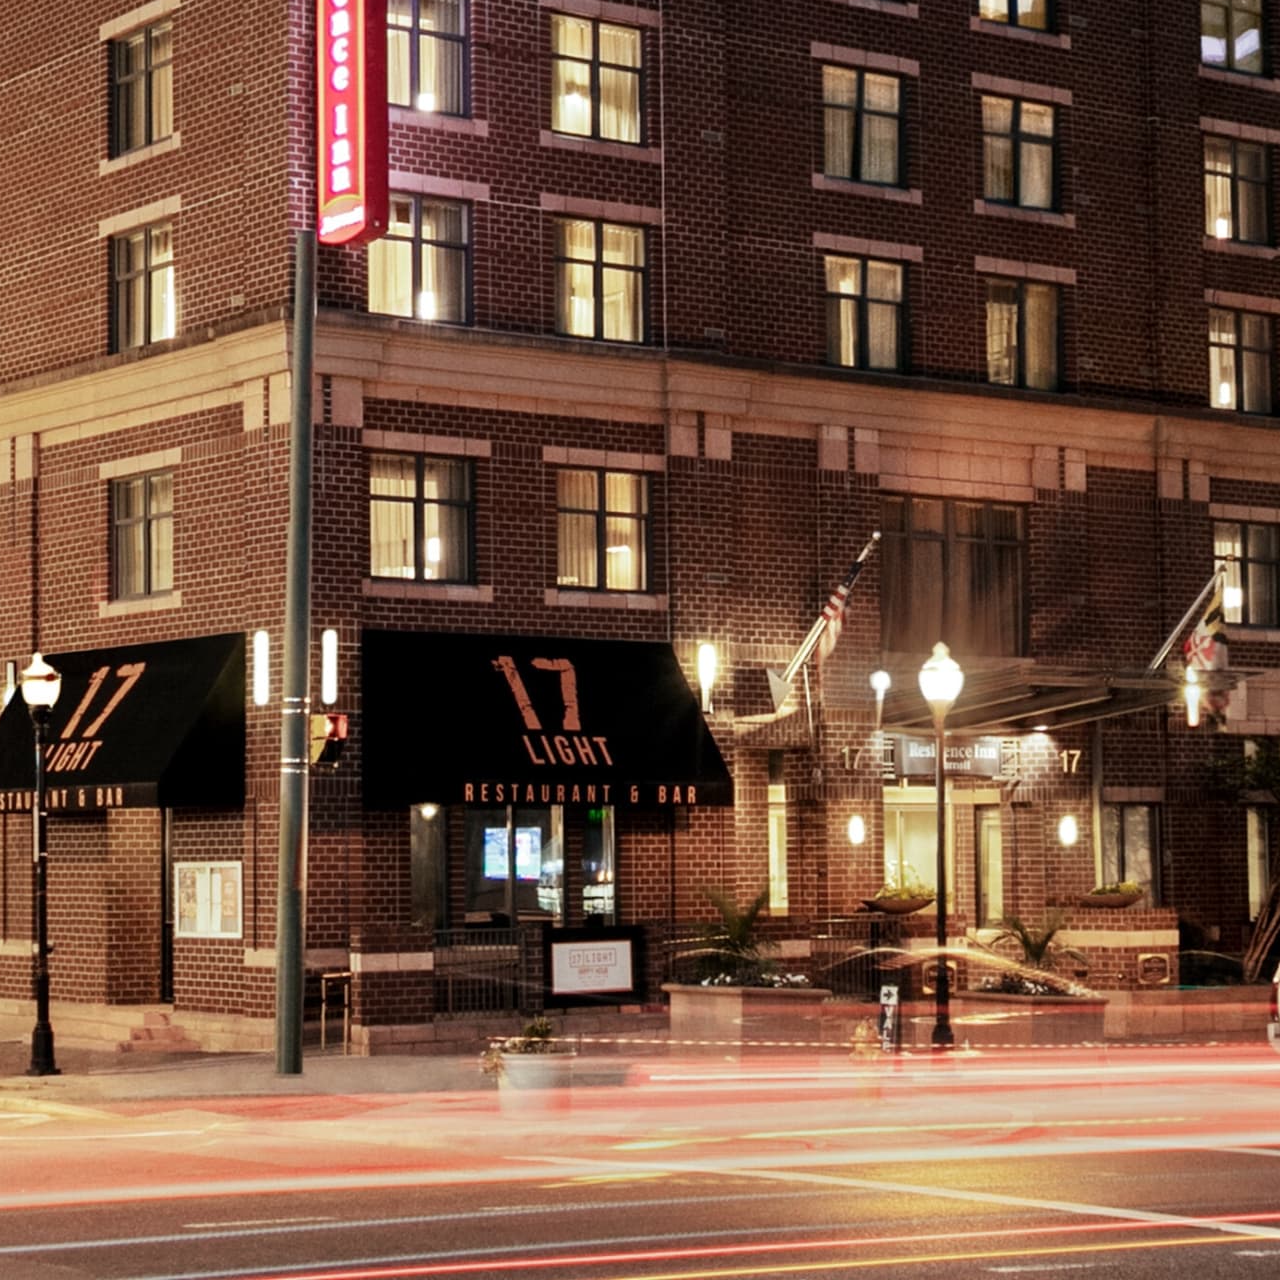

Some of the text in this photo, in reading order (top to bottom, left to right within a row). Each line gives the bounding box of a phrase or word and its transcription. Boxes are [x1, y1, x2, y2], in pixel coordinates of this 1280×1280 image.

[331, 103, 352, 193] Inn
[60, 661, 147, 739] 17
[491, 655, 581, 731] 17
[523, 735, 614, 766] LIGHT
[841, 746, 863, 770] 17
[909, 741, 997, 759] Resience Inn
[1060, 749, 1082, 774] 17
[78, 789, 86, 807] &
[96, 787, 123, 807] BAR
[465, 783, 697, 804] RESTAURANT & BAR
[585, 951, 613, 964] LIGHT
